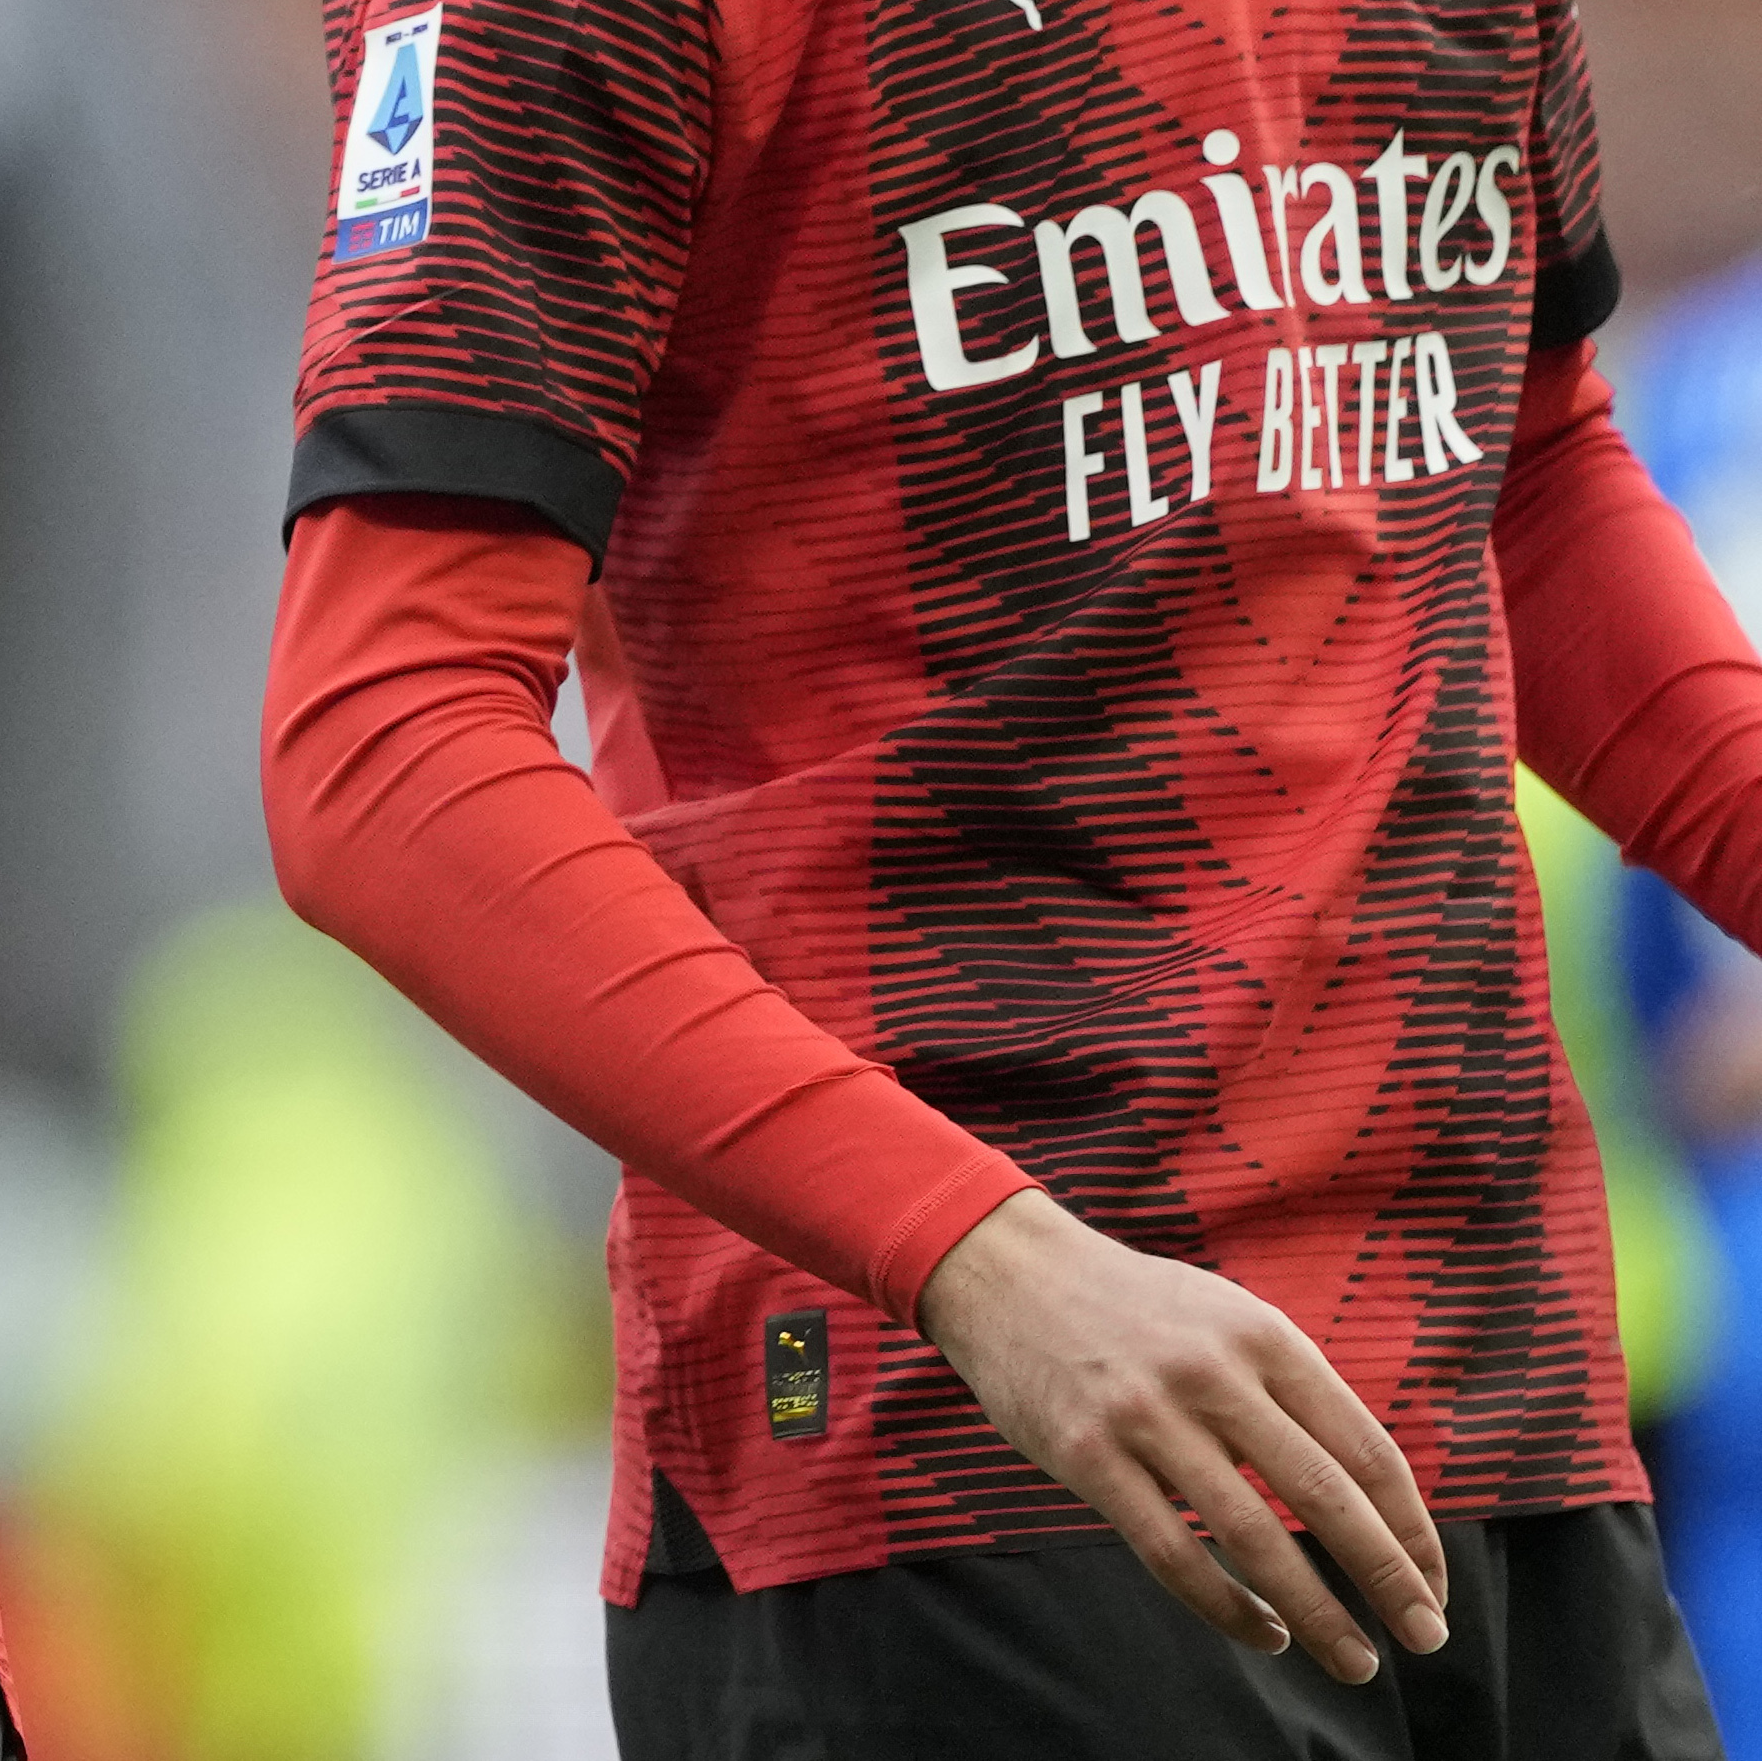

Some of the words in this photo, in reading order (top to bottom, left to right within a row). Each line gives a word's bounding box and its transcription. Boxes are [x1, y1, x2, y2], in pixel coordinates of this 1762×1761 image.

[356, 161, 409, 193] SERIE
[410, 157, 422, 181] A
[378, 210, 421, 246] TIM
[898, 128, 1521, 393] Emirates
[1062, 360, 1222, 543] FLY
[1256, 331, 1485, 494] BETTER
